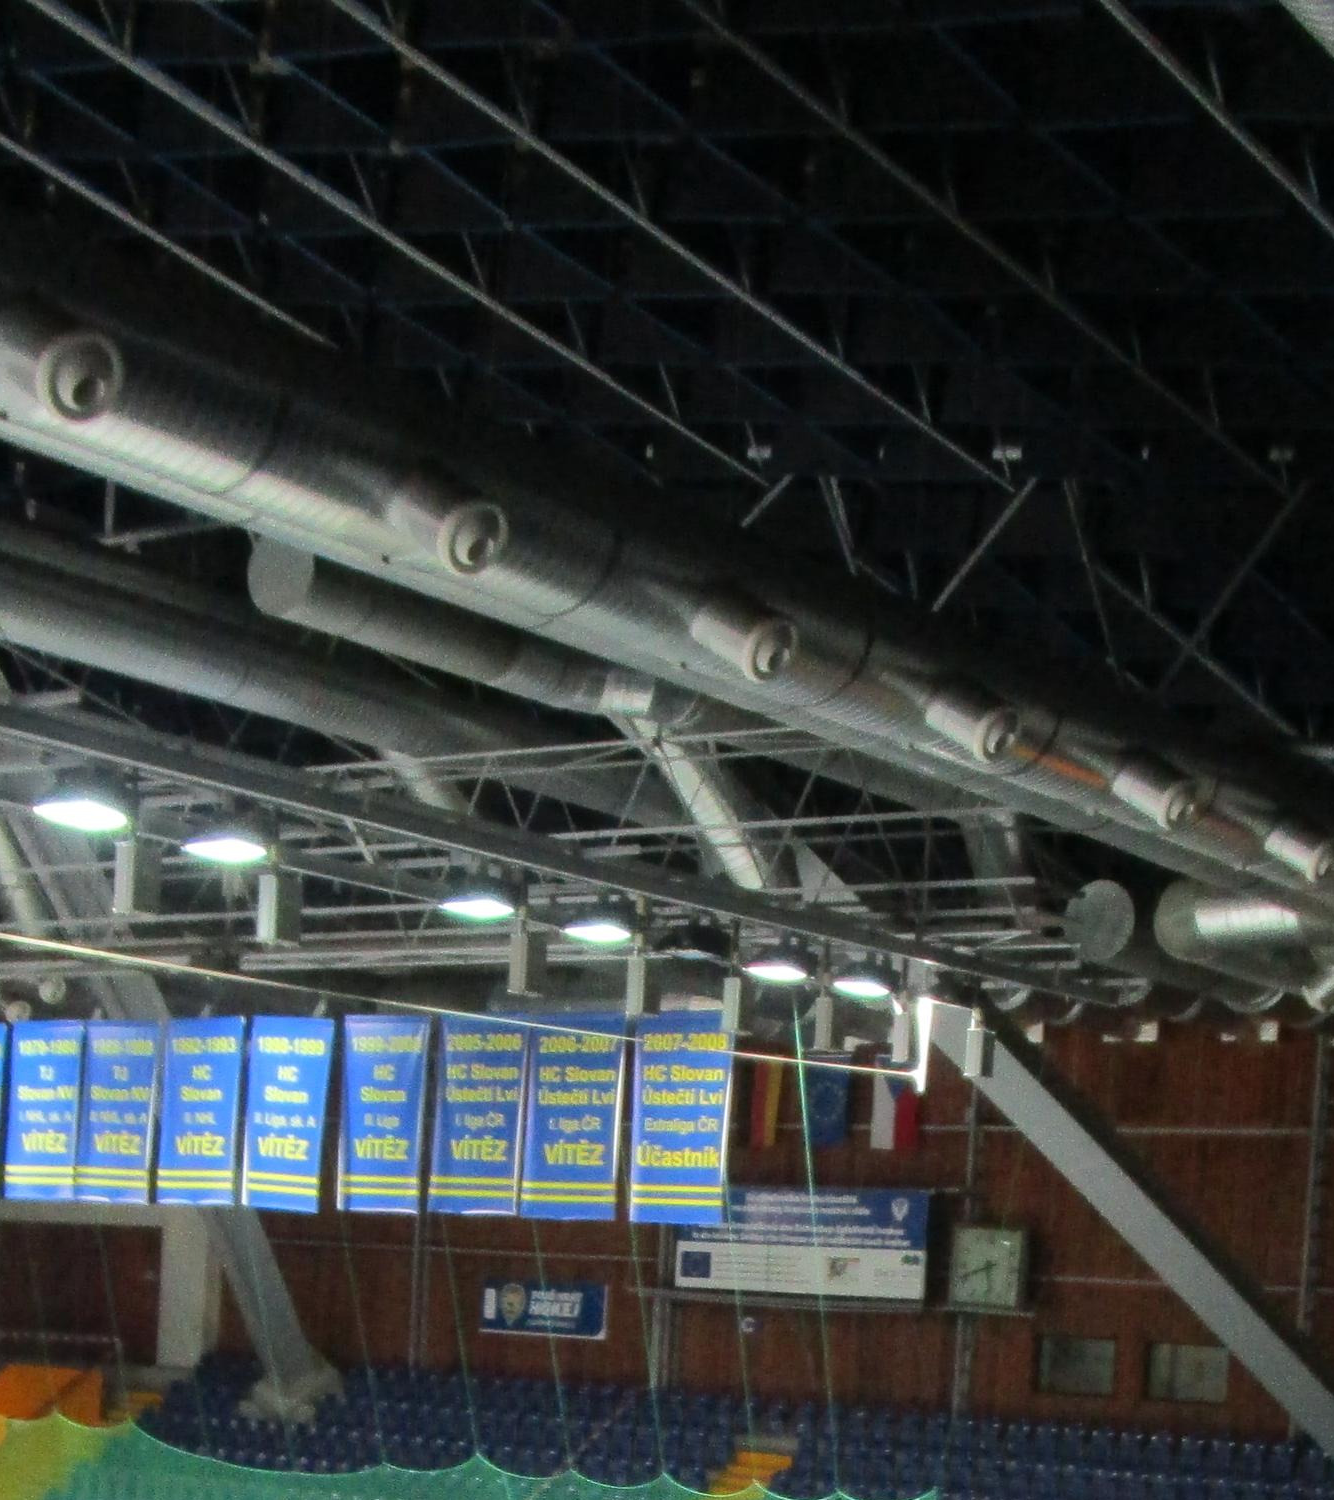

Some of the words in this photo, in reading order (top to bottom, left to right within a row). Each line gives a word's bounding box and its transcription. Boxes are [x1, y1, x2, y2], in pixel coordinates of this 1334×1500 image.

[642, 1032, 728, 1052] 2007-2008
[446, 1063, 468, 1080] HC
[471, 1063, 520, 1080] Slovan
[539, 1065, 560, 1082] HC
[565, 1065, 616, 1083] Slovan
[643, 1065, 666, 1082] HC
[670, 1064, 724, 1082] Slovan
[180, 1085, 223, 1102] Slovan
[264, 1085, 309, 1104] Slovan
[360, 1085, 407, 1102] Slovan
[642, 1084, 696, 1105] Ústečtí
[699, 1088, 724, 1105] Lvi
[22, 1129, 67, 1154] VÍTĚZ
[94, 1130, 141, 1156] VÍTĚZ
[175, 1131, 225, 1157] VÍTĚZ
[257, 1132, 309, 1161] VÍTĚZ
[354, 1133, 409, 1161] VÍTĚZ
[450, 1133, 508, 1161] VÍTĚZ
[544, 1137, 605, 1166] VÍTĚZ
[636, 1139, 720, 1168] Účastník
